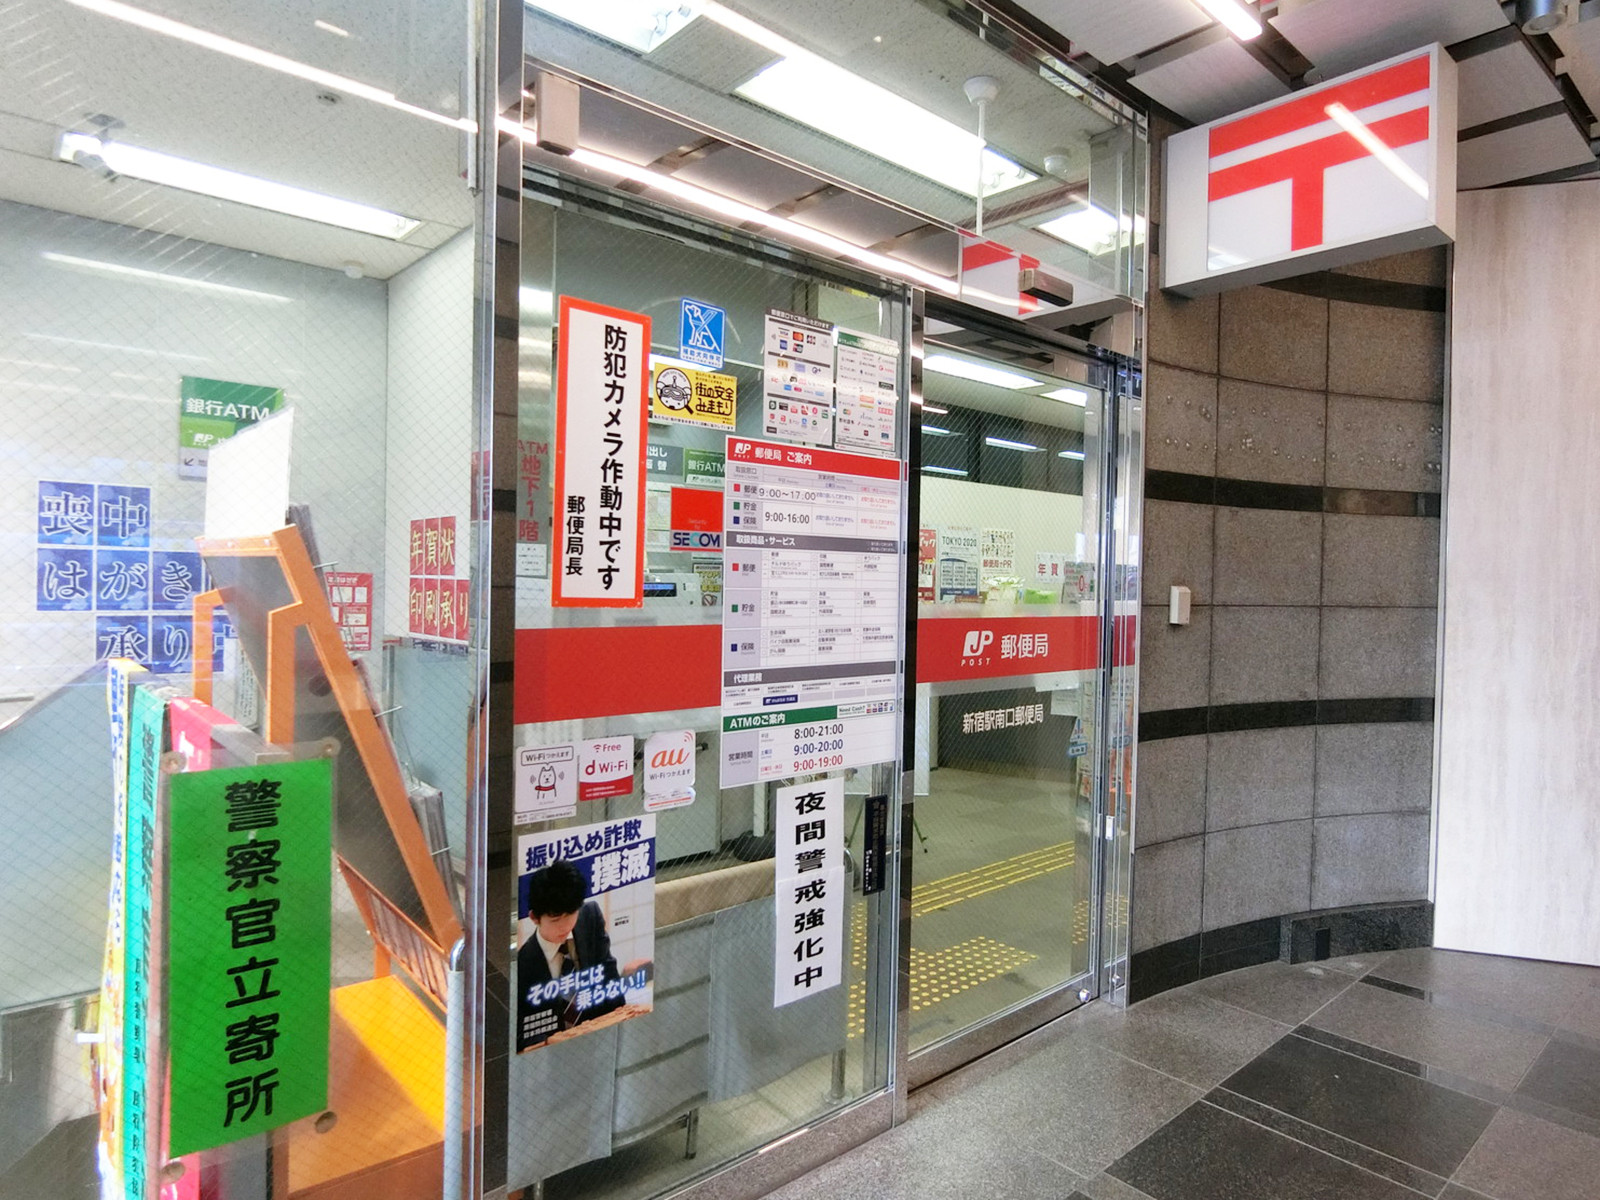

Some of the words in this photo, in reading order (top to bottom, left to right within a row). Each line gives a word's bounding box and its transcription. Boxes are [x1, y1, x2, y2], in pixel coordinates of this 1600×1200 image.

[695, 382, 734, 402] 街の安全
[186, 398, 269, 421] 銀行ATM
[598, 324, 628, 590] 防犯カメラ作動中です
[648, 446, 667, 458] 出し
[755, 447, 782, 462] 郵便局
[787, 451, 813, 465] ご案内
[688, 460, 725, 473] 銀行ATM
[744, 485, 757, 495] 郵便
[42, 490, 147, 539] 喪中
[743, 502, 757, 512] 貯金
[765, 511, 810, 525] 9:00-16:00
[566, 495, 586, 576] 郵便局長
[673, 532, 720, 548] SECOM
[736, 534, 796, 546] 取扱商品・サービス
[941, 536, 962, 548] TOKYO
[962, 537, 978, 549] 2020
[411, 528, 454, 568] 年賀状
[742, 564, 756, 574] 郵便
[43, 561, 194, 603] はがき
[410, 588, 469, 630] 印刷承り
[741, 603, 755, 612] 貯金
[741, 643, 755, 653] 保険
[963, 630, 994, 657] JP
[1001, 633, 1049, 660] 郵便局
[961, 658, 992, 667] POST
[729, 713, 786, 729] ATMのご案内
[962, 703, 1044, 734] 新宿駅南口郵便局
[794, 723, 844, 740] 8:00-21:00
[602, 743, 622, 752] Free
[729, 750, 754, 762] 営業時間
[794, 739, 844, 756] 9:00-20:00
[525, 751, 570, 763] Wi-Fiつかえます
[651, 747, 691, 769] au
[794, 755, 843, 772] 9:00-19:00
[585, 760, 597, 776] d
[599, 760, 628, 773] Wi-Fi
[526, 818, 642, 872] 振り込め詐欺
[591, 841, 651, 895] 撲滅
[794, 792, 826, 988] 夜間警戒強化中
[223, 778, 282, 1129] 警察官立寄所
[527, 963, 605, 1006] その手には
